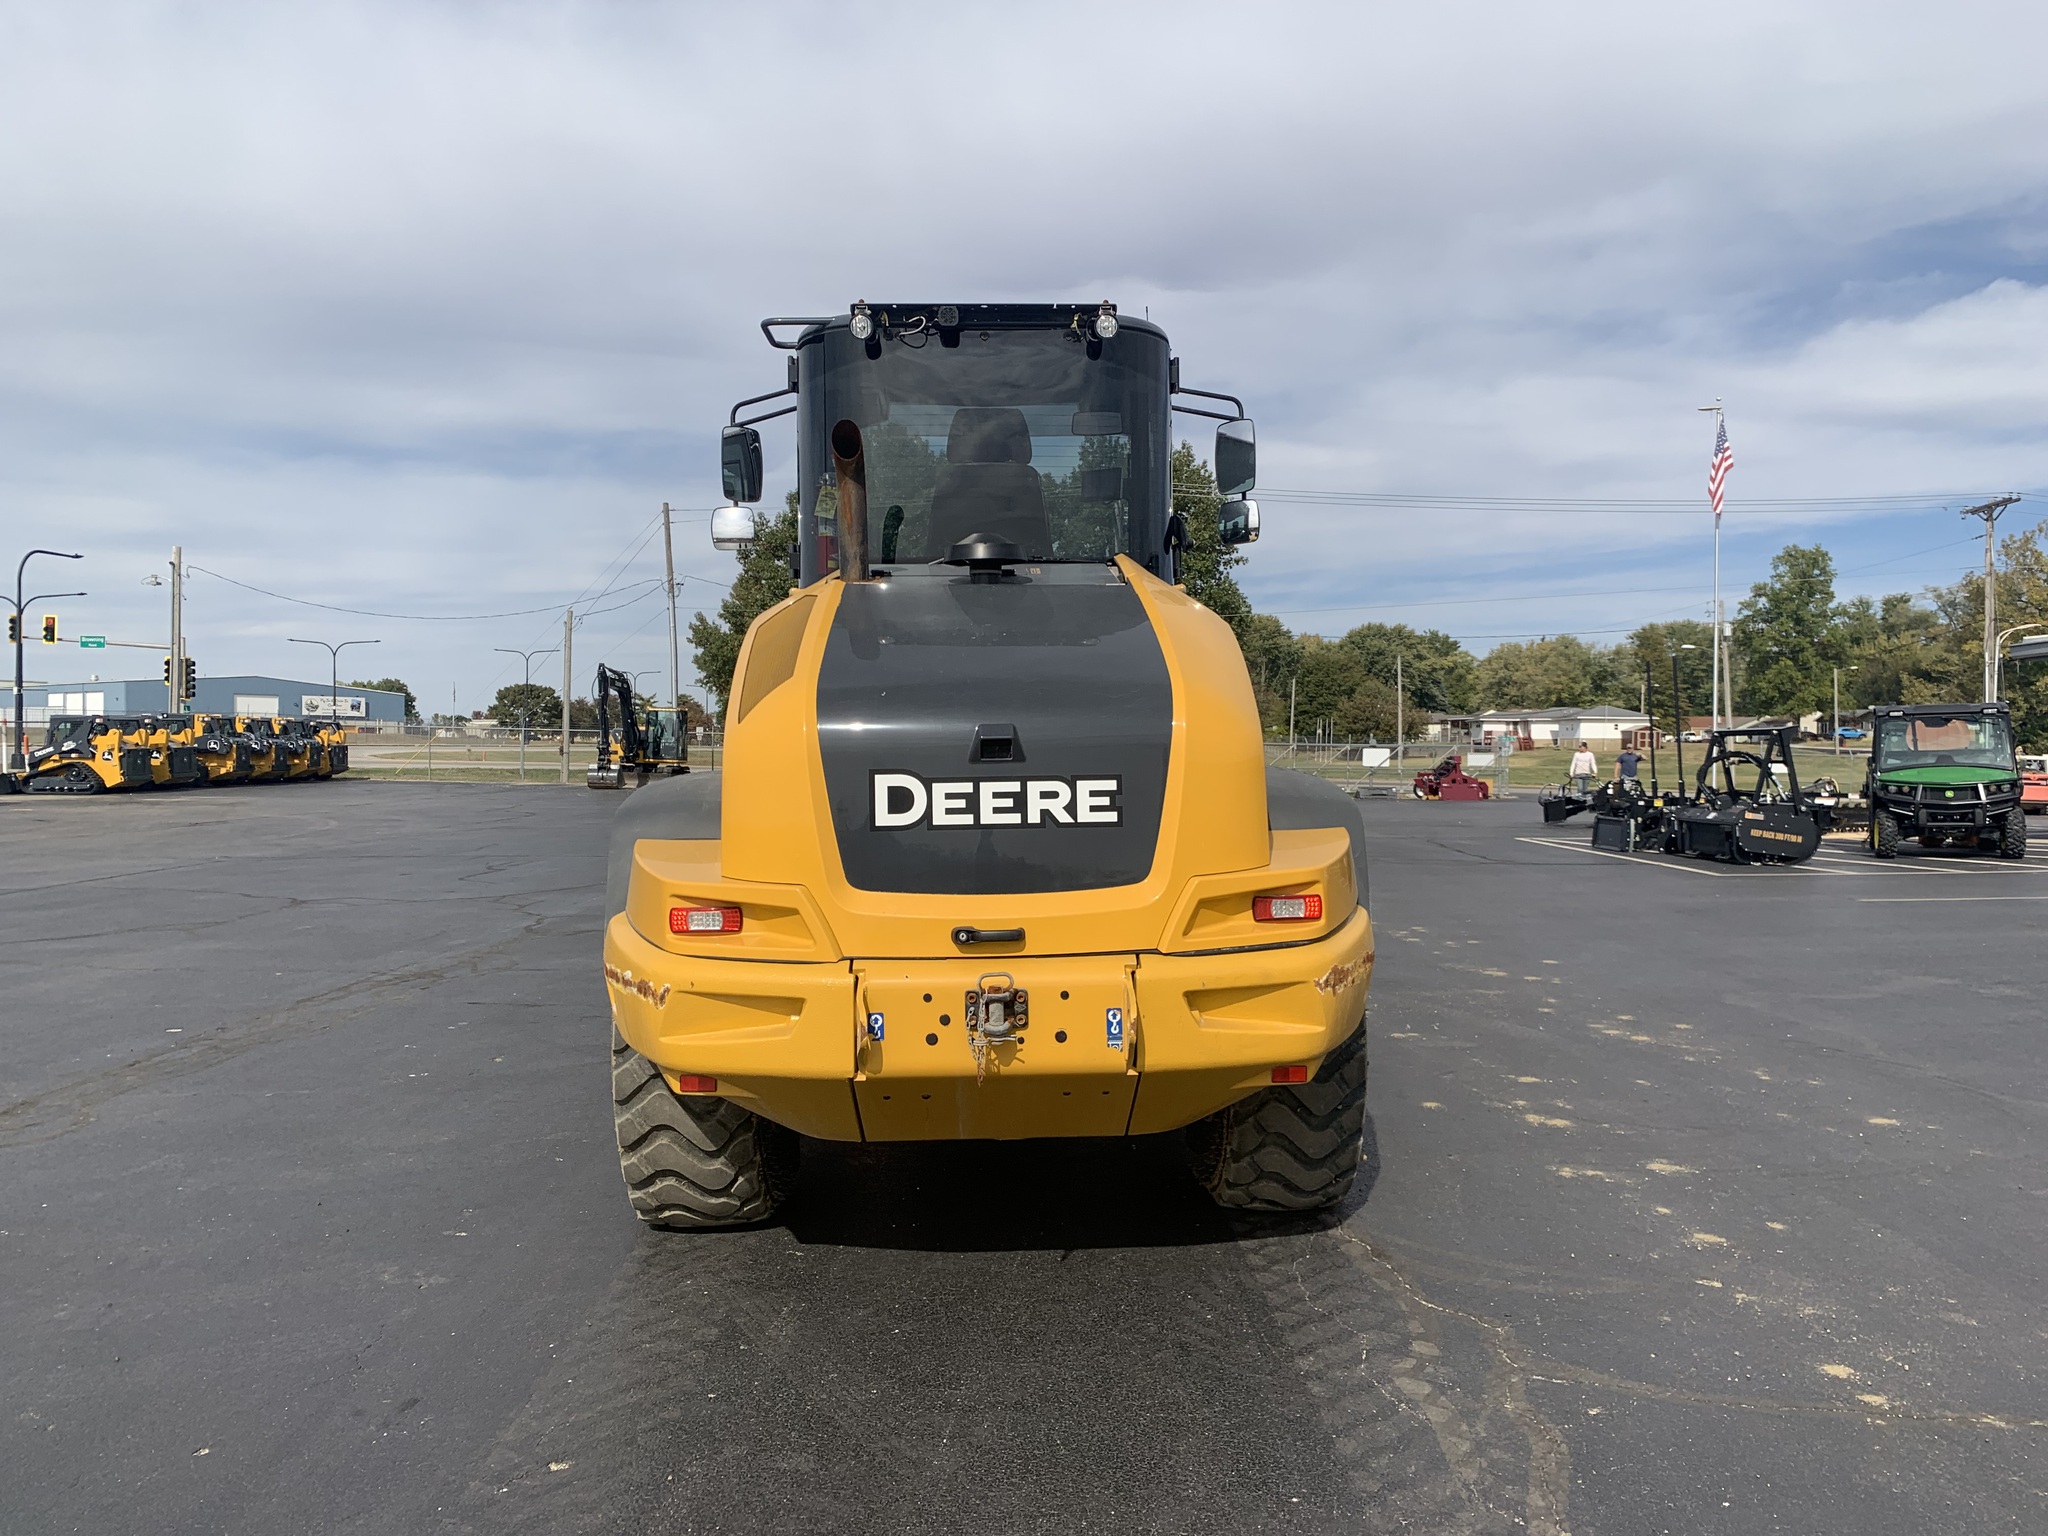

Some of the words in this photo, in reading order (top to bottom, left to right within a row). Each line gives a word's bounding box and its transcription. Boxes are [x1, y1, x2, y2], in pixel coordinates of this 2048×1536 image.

[34, 746, 54, 757] DEERE
[874, 774, 1118, 827] DEERE
[1750, 828, 1762, 837] KEEP
[1762, 830, 1774, 839] BACK
